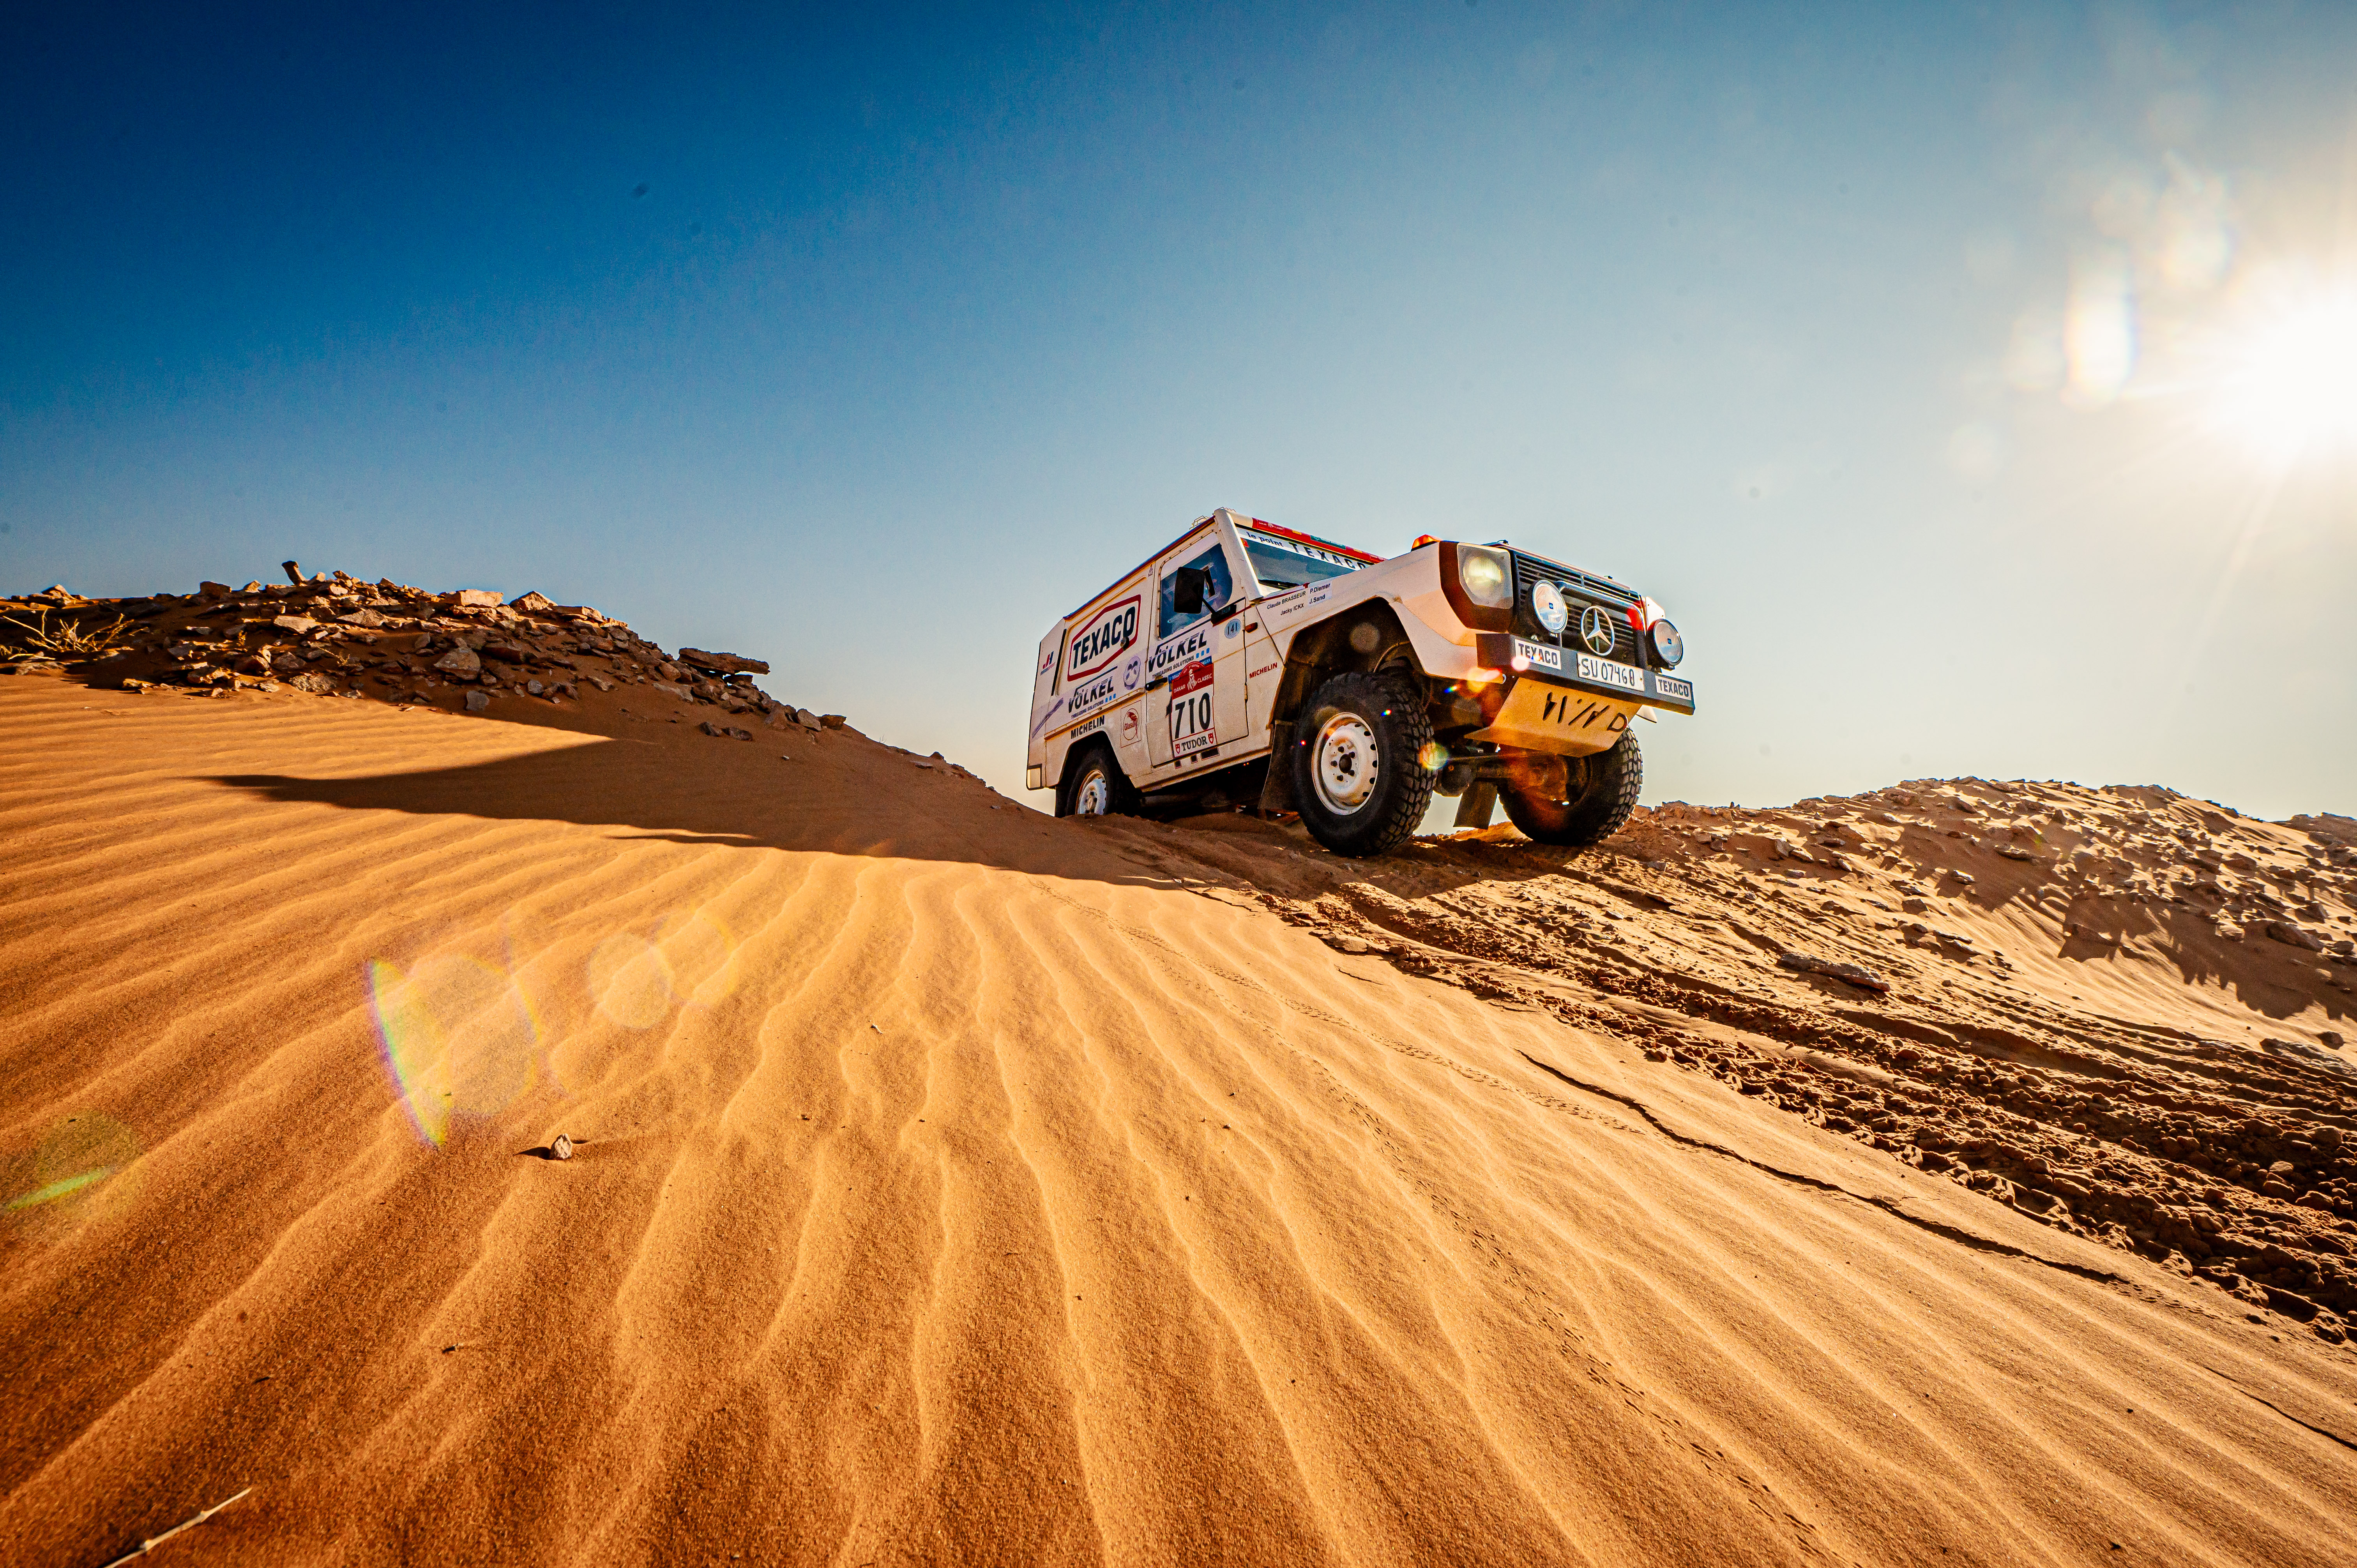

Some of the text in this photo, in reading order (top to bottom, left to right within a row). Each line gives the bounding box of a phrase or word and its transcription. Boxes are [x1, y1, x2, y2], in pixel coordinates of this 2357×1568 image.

[1247, 531, 1256, 539] le
[1258, 537, 1284, 547] point
[1288, 542, 1366, 569] TEXACO
[1267, 591, 1306, 609] Claude BRASSEUR
[1309, 594, 1325, 604] J.Sand
[1073, 606, 1135, 669] TEXACO
[1228, 622, 1238, 635] 141
[1148, 629, 1207, 673] VÖLKEL
[1518, 643, 1558, 666] TEXACO
[1152, 655, 1194, 679] THREADING SOLUTIONS
[1249, 662, 1277, 679] MICHELIN
[1581, 658, 1597, 678] SU
[1197, 673, 1212, 683] CLASSIC
[1068, 676, 1114, 713] VÖLKEL
[1173, 684, 1186, 693] DAKAR
[1658, 679, 1689, 697] TEXACO
[1071, 700, 1104, 719] THREADING SOLUTIONS
[1175, 692, 1210, 739] 710
[1071, 715, 1105, 739] MICHELIN
[1181, 736, 1208, 751] TUDOR
